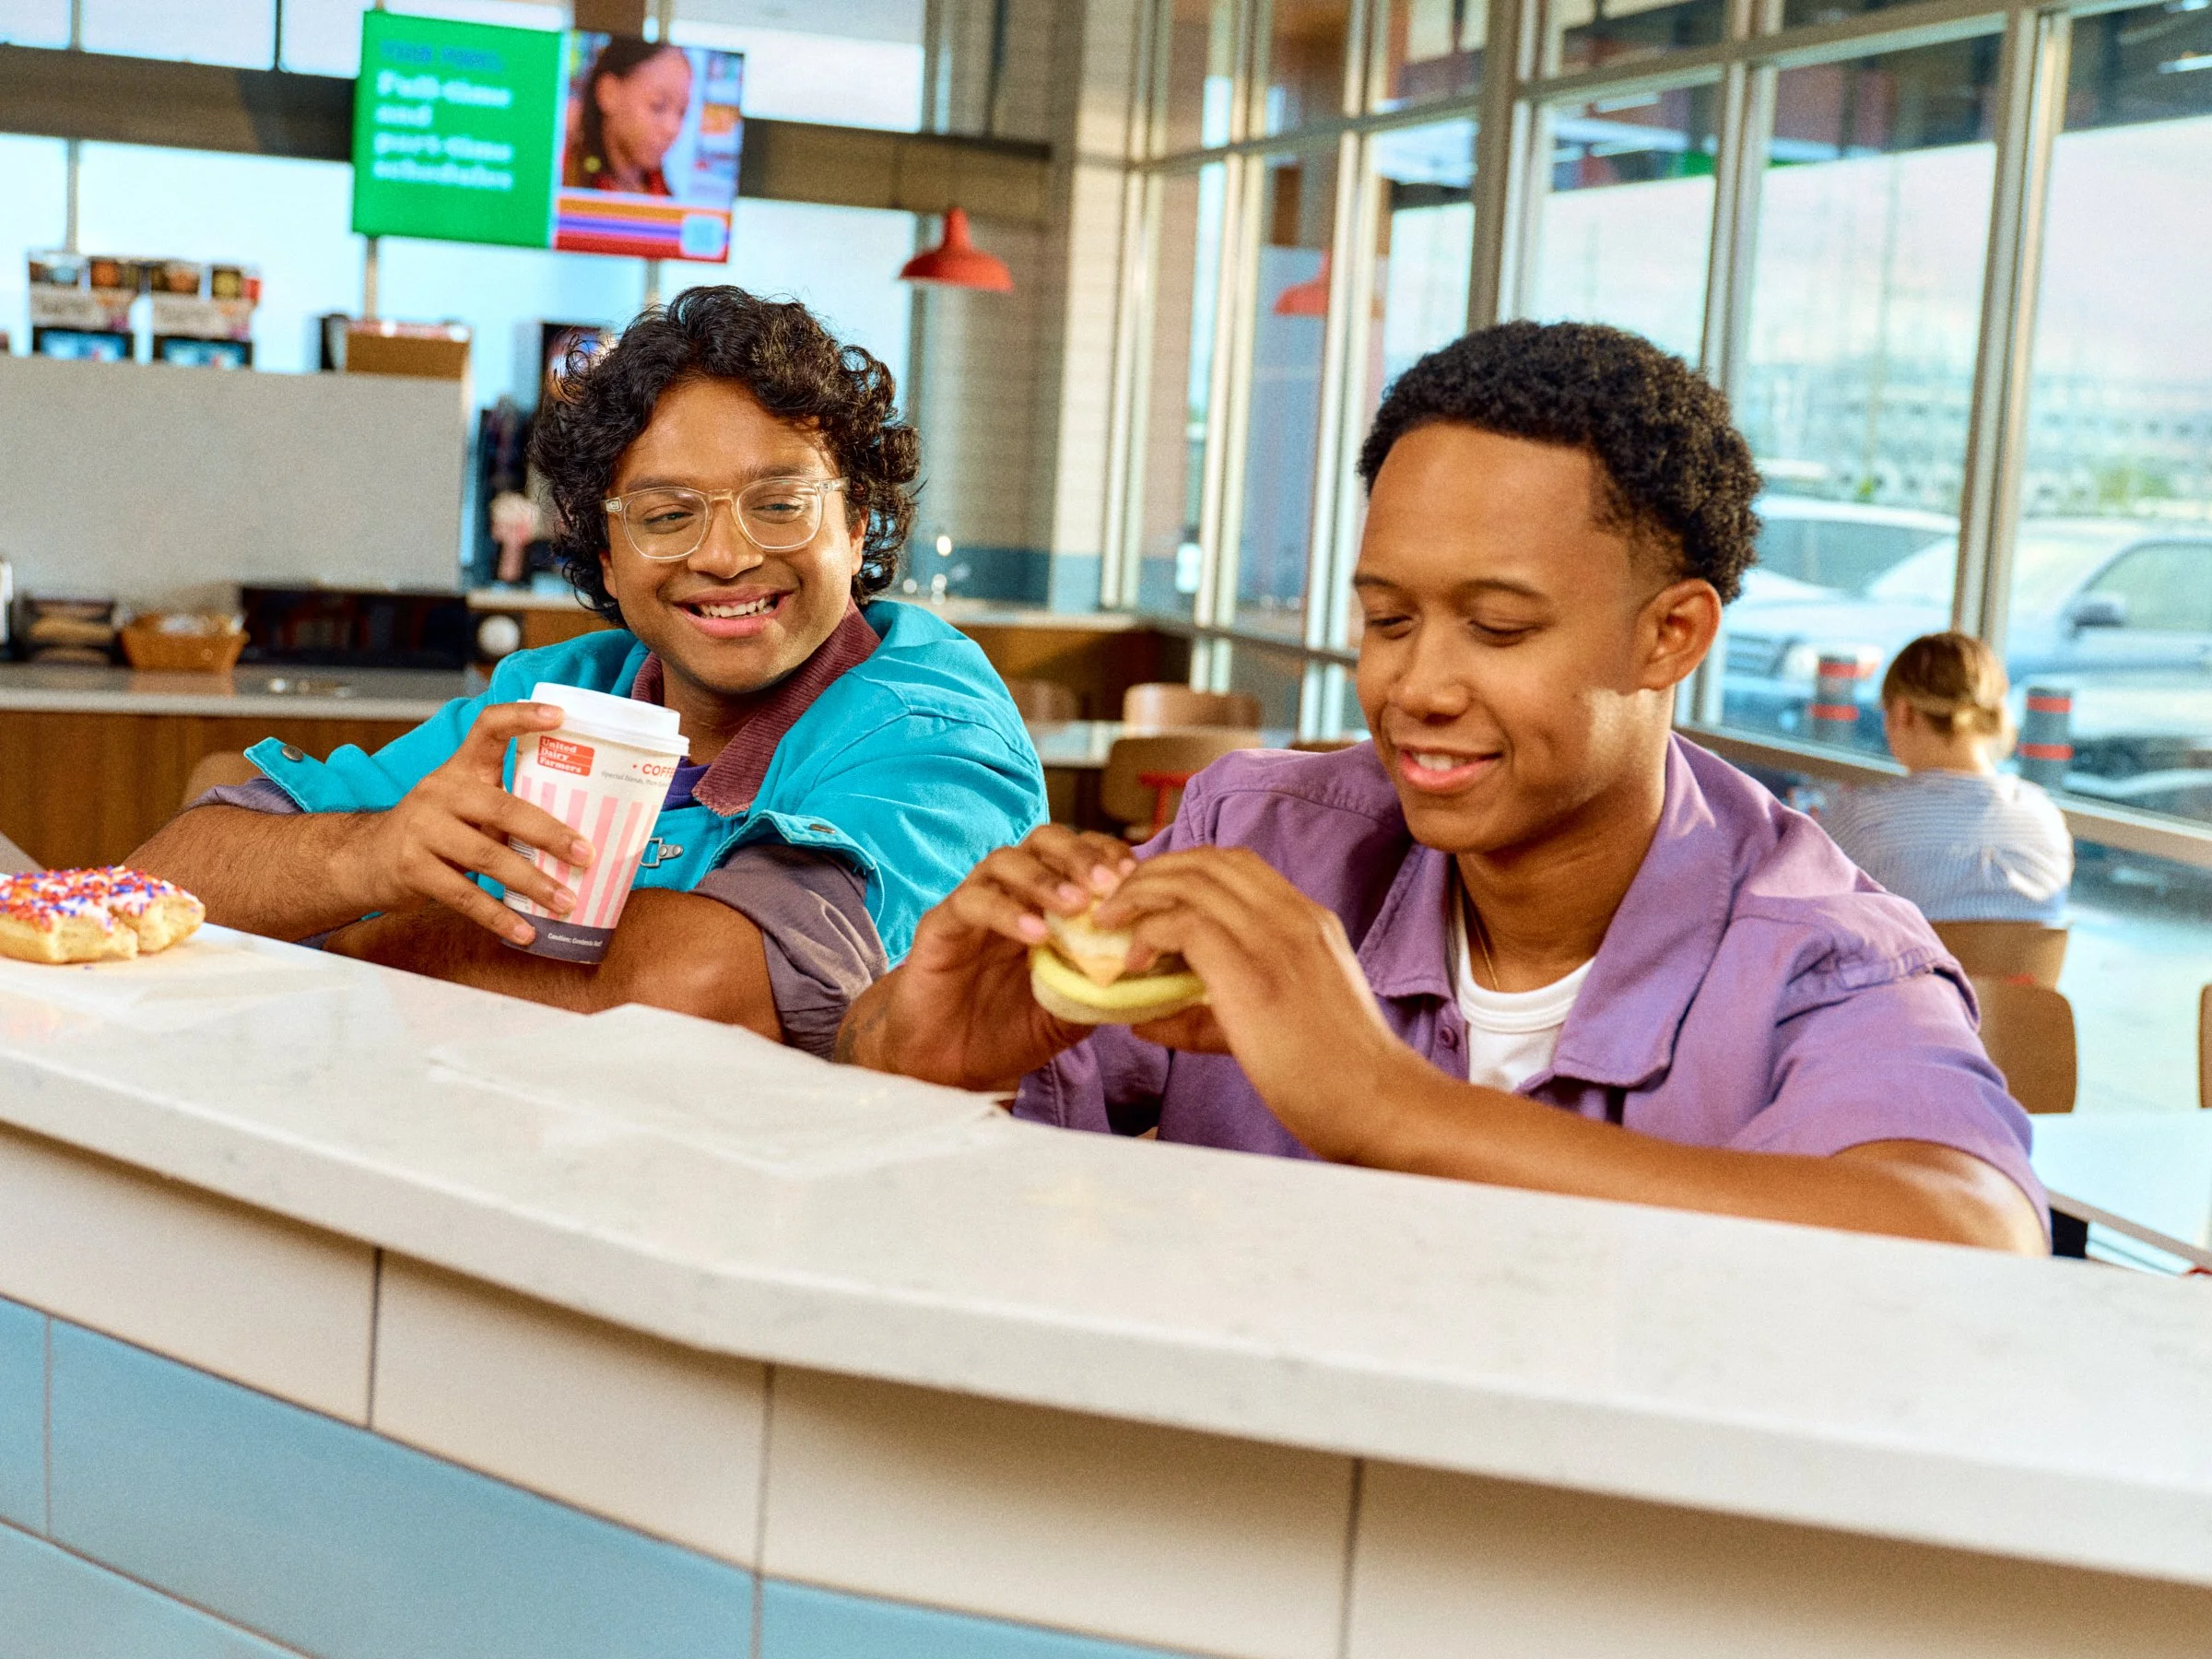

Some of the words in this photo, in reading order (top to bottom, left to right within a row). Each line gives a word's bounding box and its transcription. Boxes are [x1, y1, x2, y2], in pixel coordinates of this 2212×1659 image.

[542, 738, 577, 753] United
[541, 747, 568, 761] Dairy
[540, 756, 582, 773] Farmers
